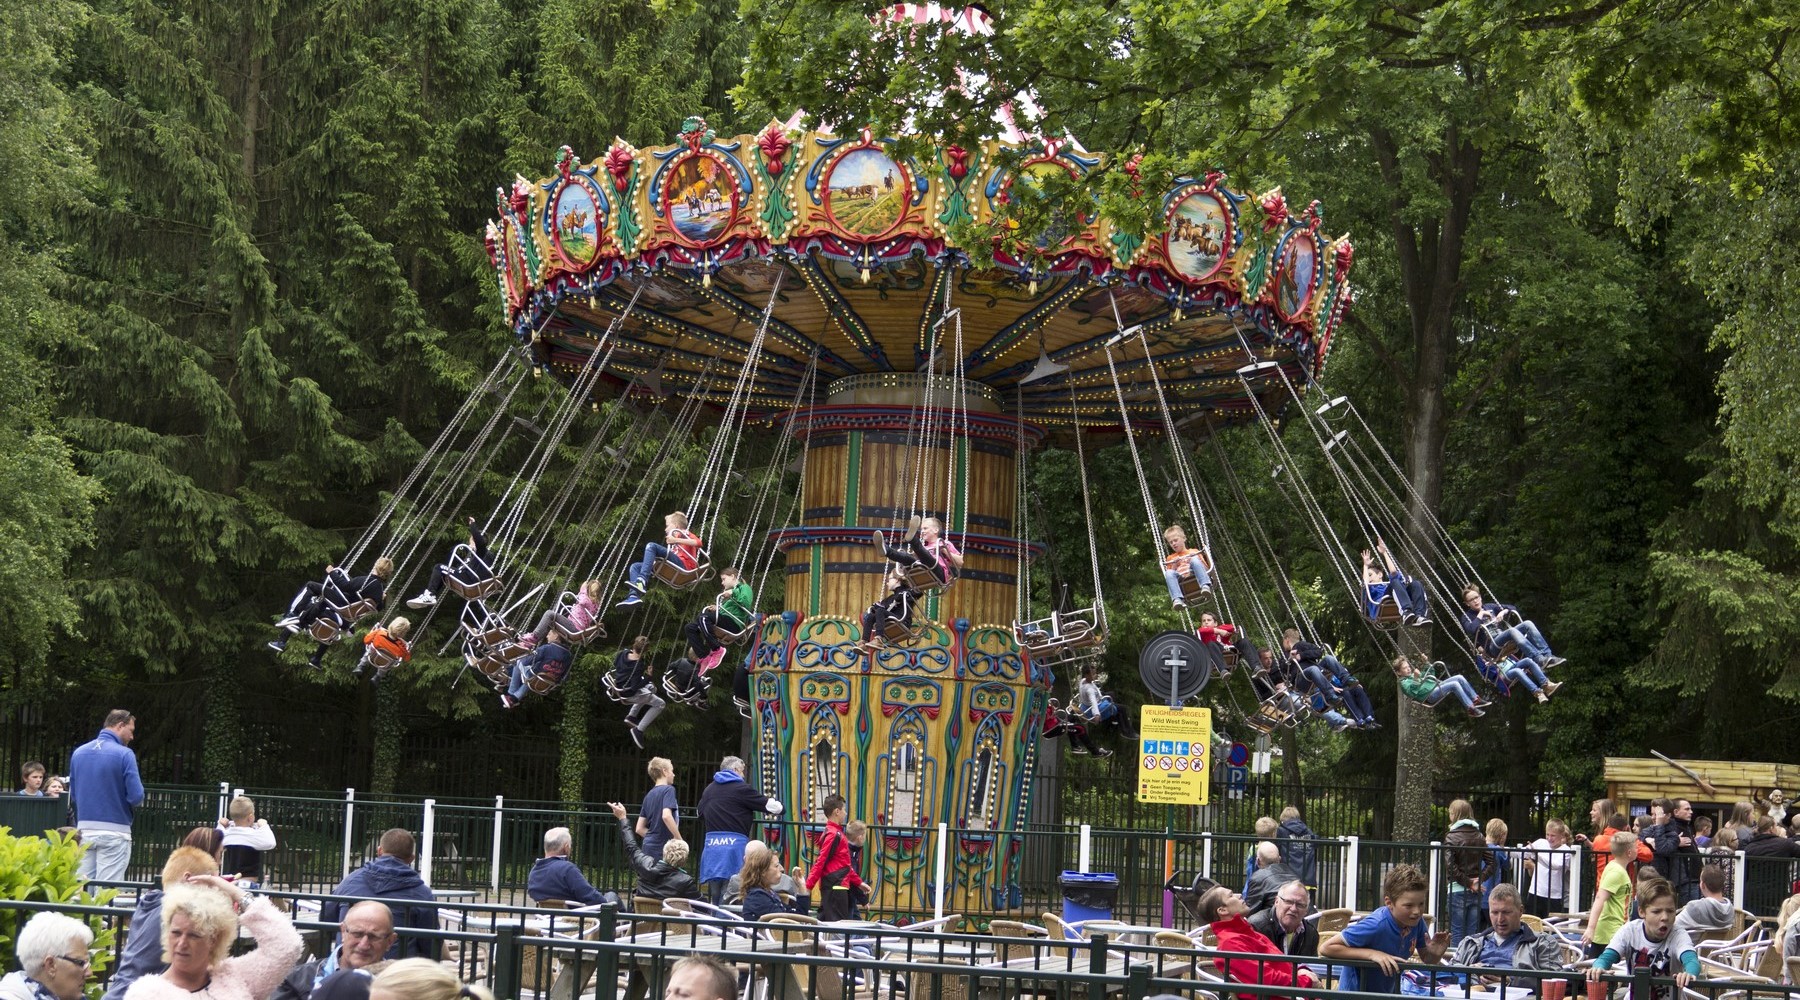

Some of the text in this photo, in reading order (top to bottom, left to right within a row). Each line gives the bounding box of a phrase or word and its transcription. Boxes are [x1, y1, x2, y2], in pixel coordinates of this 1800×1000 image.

[1144, 709, 1206, 718] VEILIGHEIDSREGELS
[1232, 770, 1242, 787] P
[708, 838, 736, 846] JAMY
